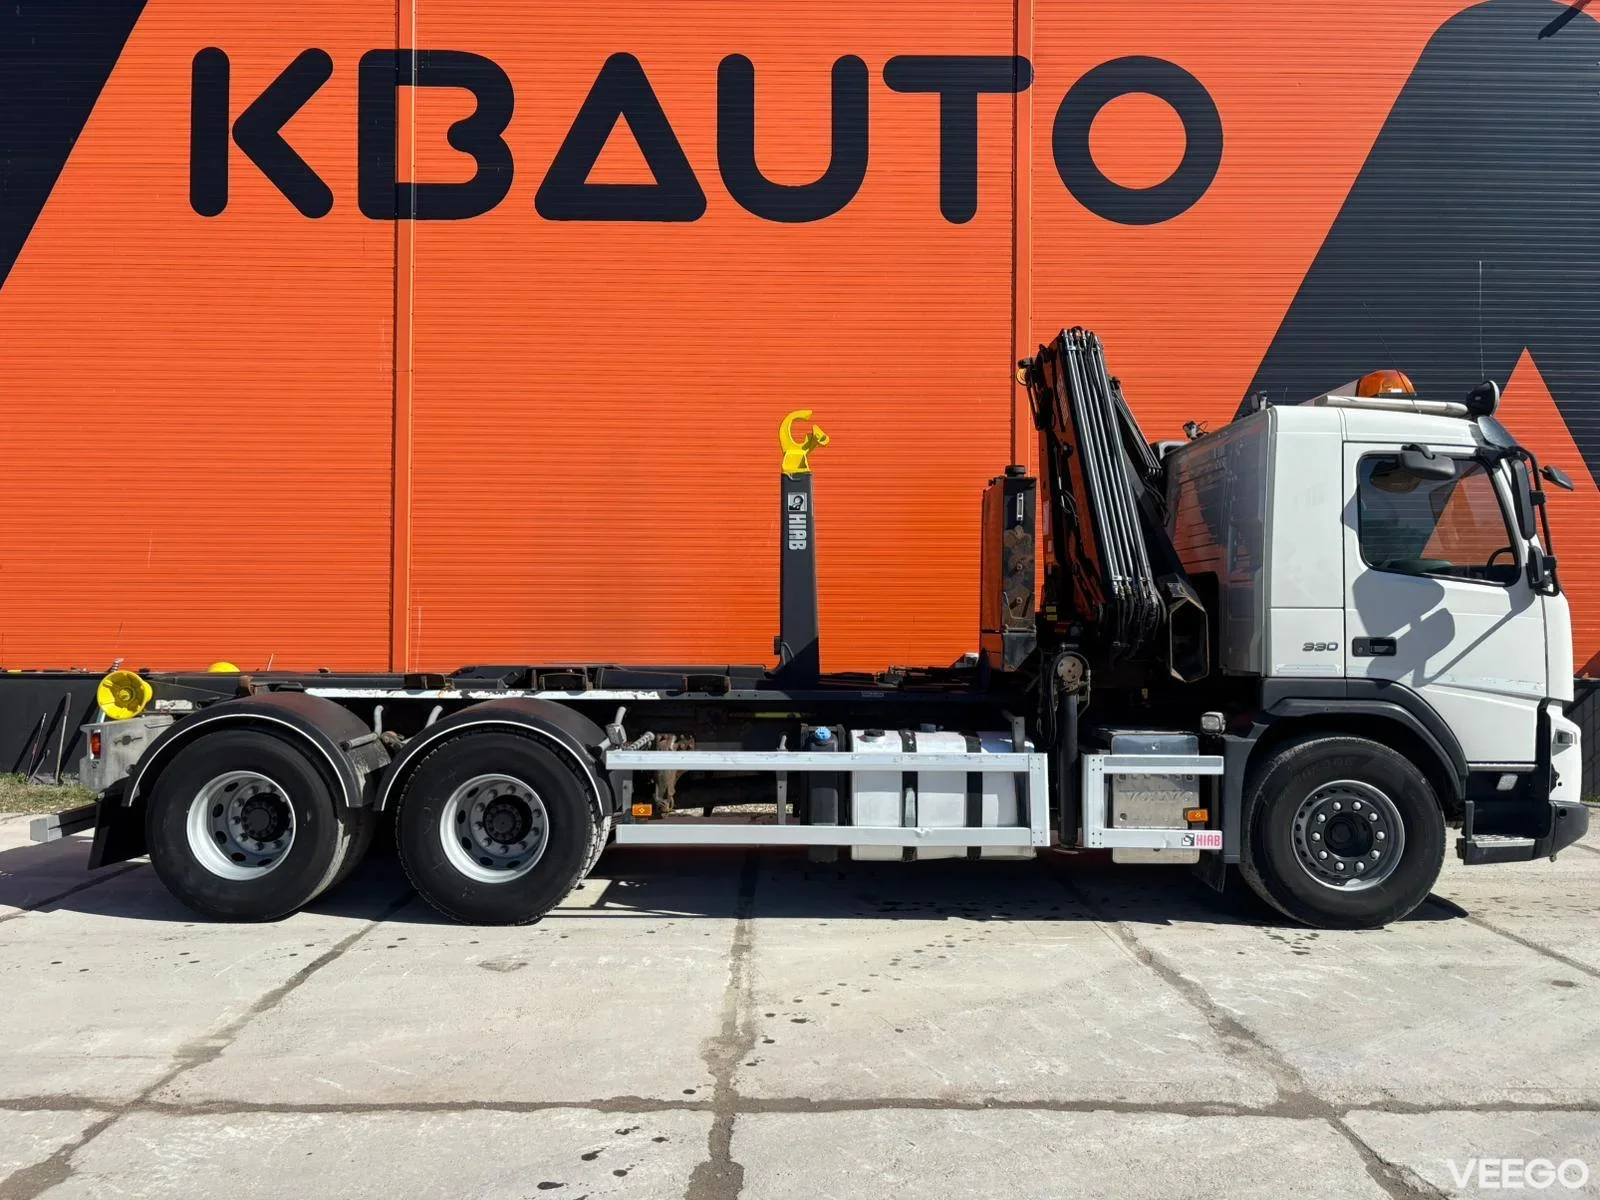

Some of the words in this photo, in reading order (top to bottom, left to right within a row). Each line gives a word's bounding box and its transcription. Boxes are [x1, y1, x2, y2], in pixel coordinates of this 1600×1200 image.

[190, 46, 1223, 225] KBAUTO
[788, 513, 807, 550] HIAB
[1302, 642, 1339, 651] 330
[1196, 834, 1221, 847] HIAB
